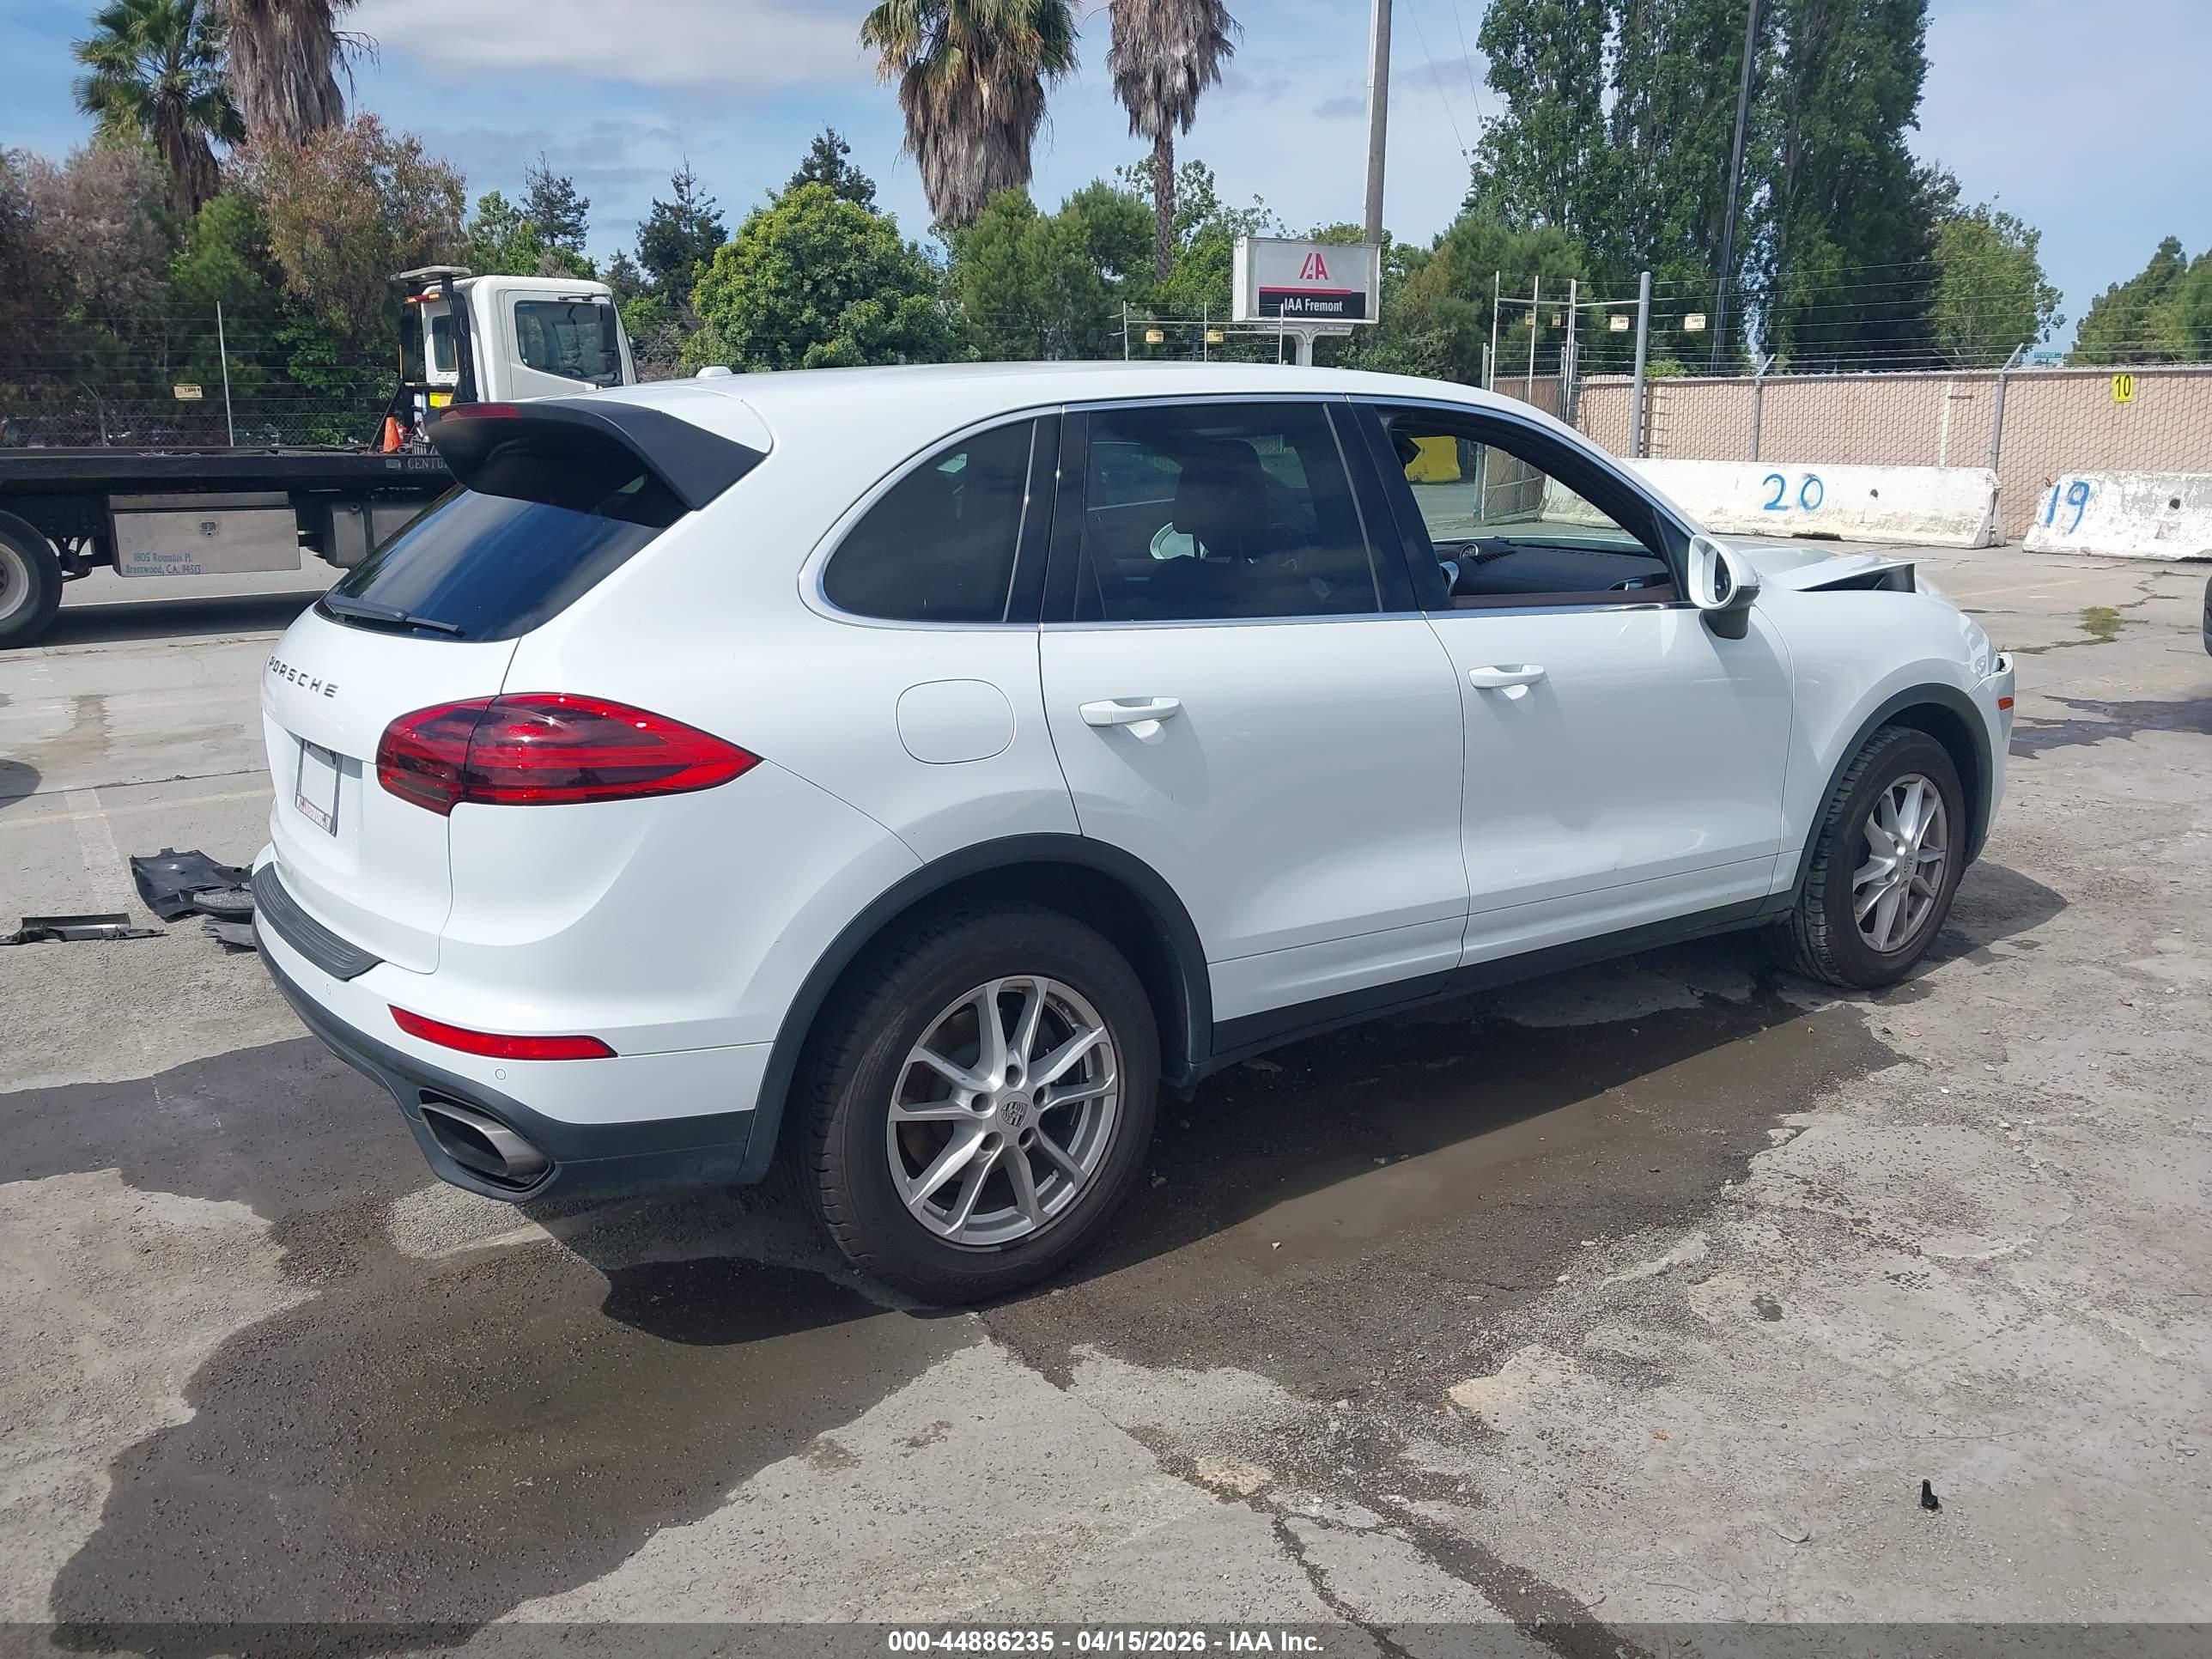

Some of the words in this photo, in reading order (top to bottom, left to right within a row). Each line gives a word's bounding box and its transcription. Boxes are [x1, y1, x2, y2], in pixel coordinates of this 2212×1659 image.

[1284, 297, 1303, 311] IAA
[1304, 298, 1343, 313] Fremont
[2115, 374, 2131, 398] 10
[407, 458, 447, 469] CENTU
[1762, 473, 1824, 511] 20
[2045, 481, 2090, 535] 19
[133, 553, 150, 562] 1805
[153, 552, 183, 562] Romulus
[268, 655, 339, 699] PORSCHE
